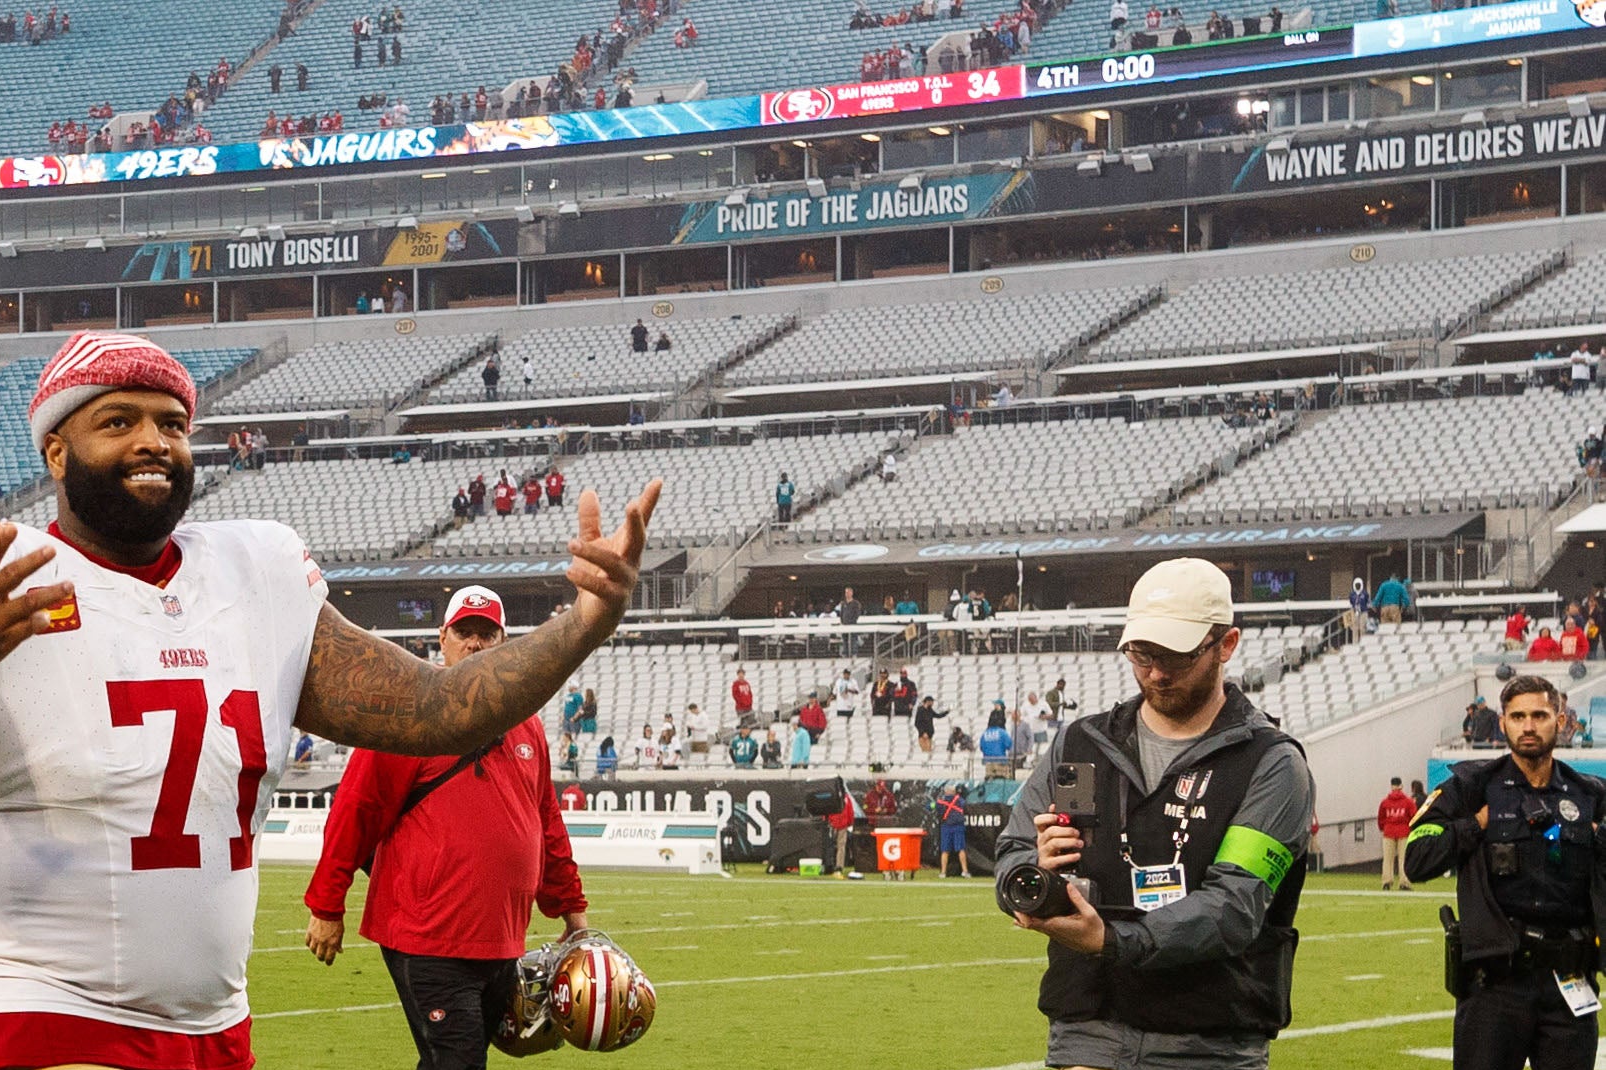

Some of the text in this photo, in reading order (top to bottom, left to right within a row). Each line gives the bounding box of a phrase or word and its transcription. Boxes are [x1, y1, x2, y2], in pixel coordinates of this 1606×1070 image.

[1469, 1, 1558, 24] JACKSONVILLE
[1387, 21, 1406, 48] 3
[1486, 17, 1542, 37] JAGUARS
[1283, 31, 1320, 46] BALL ON
[1037, 54, 1155, 89] 4TH 0:00
[837, 80, 920, 101] SAN FRANCISCO
[968, 70, 1001, 99] 34
[861, 97, 895, 110] 49ERS
[931, 89, 943, 105] 0
[117, 146, 219, 179] 49ERS
[301, 126, 437, 167] JAGUARS
[1265, 114, 1606, 182] WAYNE AND DELORES WEAV
[717, 183, 969, 233] PRIDE OF THE JAGUARS
[405, 231, 438, 244] 1995-
[189, 235, 359, 272] 71 TONY BOSELLI
[410, 243, 440, 257] 2001
[1354, 247, 1372, 259] 210
[917, 522, 1383, 558] Gallagher INSURANCE
[159, 648, 210, 669] 49ERS
[737, 742, 751, 756] 21
[105, 678, 268, 872] 71
[1164, 802, 1207, 820] MEIA
[608, 827, 657, 841] JAGUARS
[882, 837, 902, 862] G
[1145, 872, 1171, 886] 2023
